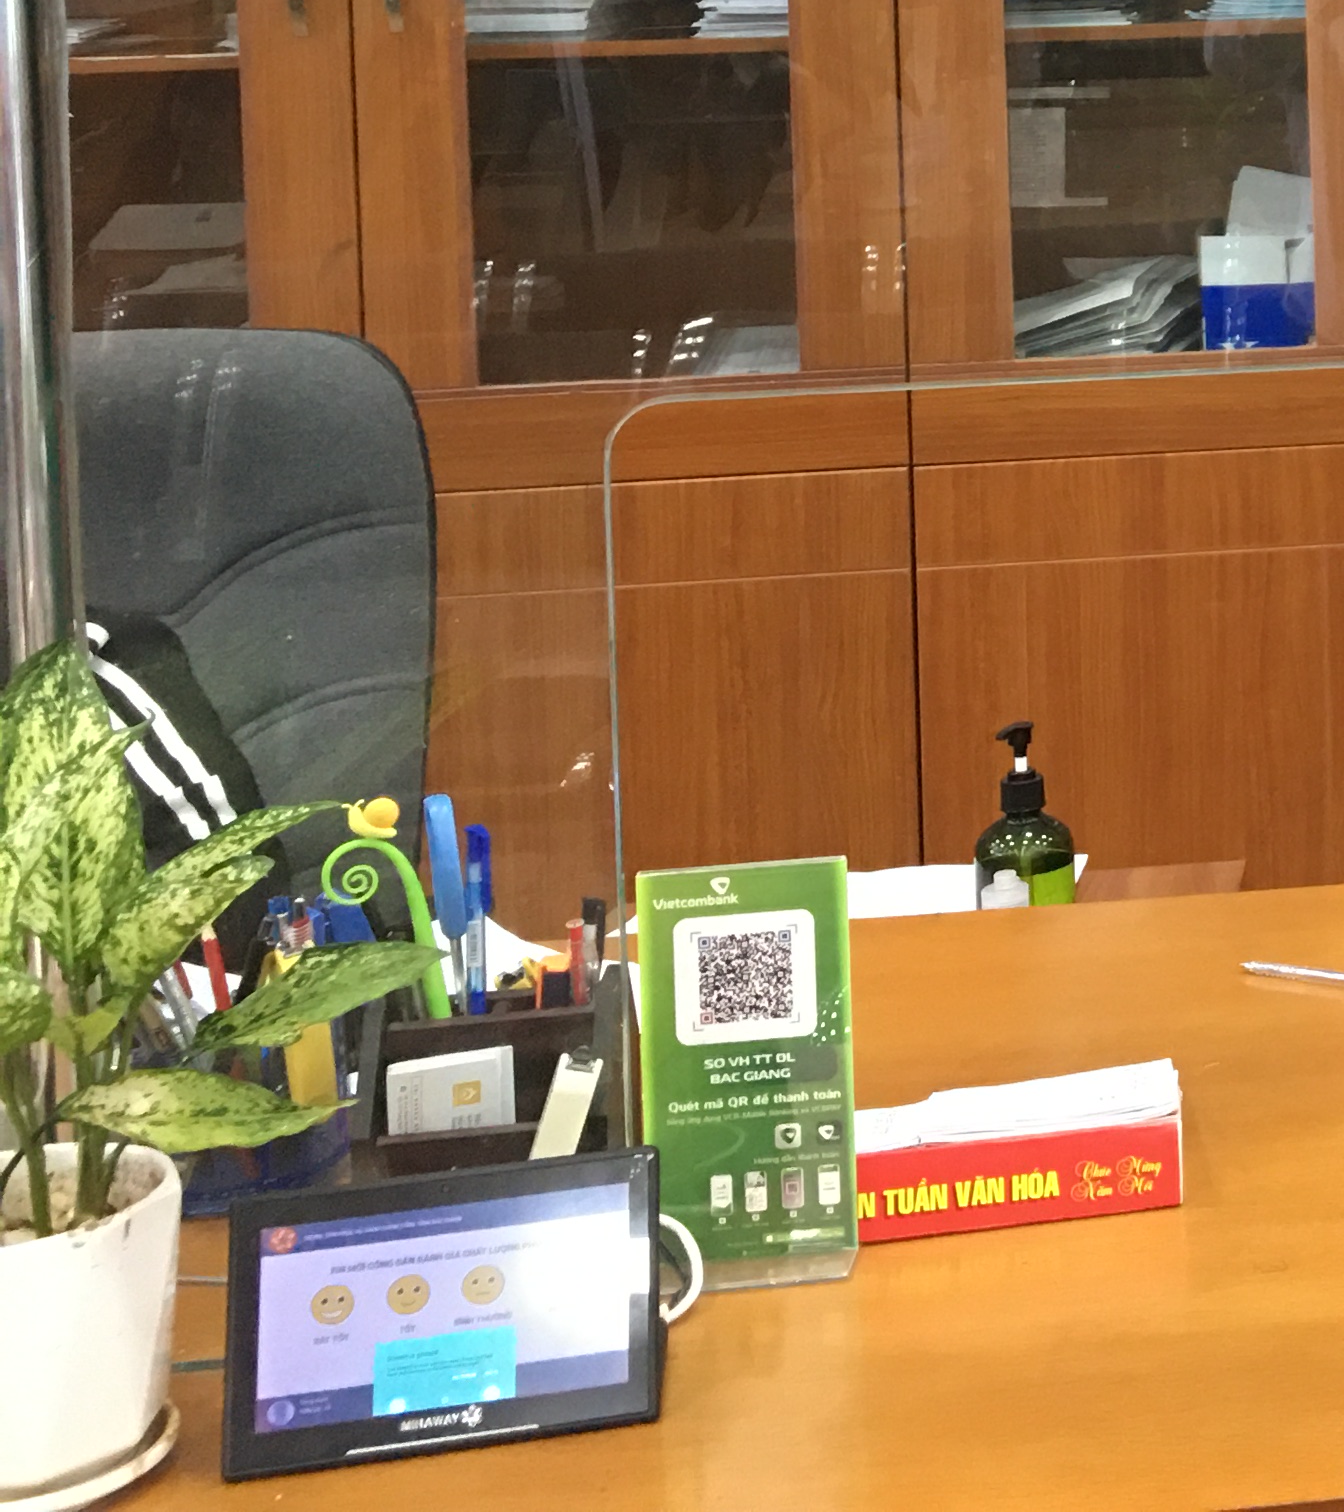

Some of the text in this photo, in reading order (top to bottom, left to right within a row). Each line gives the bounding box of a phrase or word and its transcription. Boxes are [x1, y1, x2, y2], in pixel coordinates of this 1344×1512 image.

[652, 892, 739, 910] Vietcombank
[703, 1057, 726, 1071] SO
[728, 1055, 751, 1067] VH
[752, 1053, 773, 1065] TT
[710, 1067, 792, 1085] BAC GIANG
[668, 1101, 700, 1114] Quét
[703, 1097, 724, 1110] mã
[727, 1096, 749, 1108] QR
[773, 1090, 809, 1104] thanh
[813, 1089, 842, 1101] toán
[955, 1174, 1005, 1208] VĂN
[1012, 1167, 1060, 1202] HÓA
